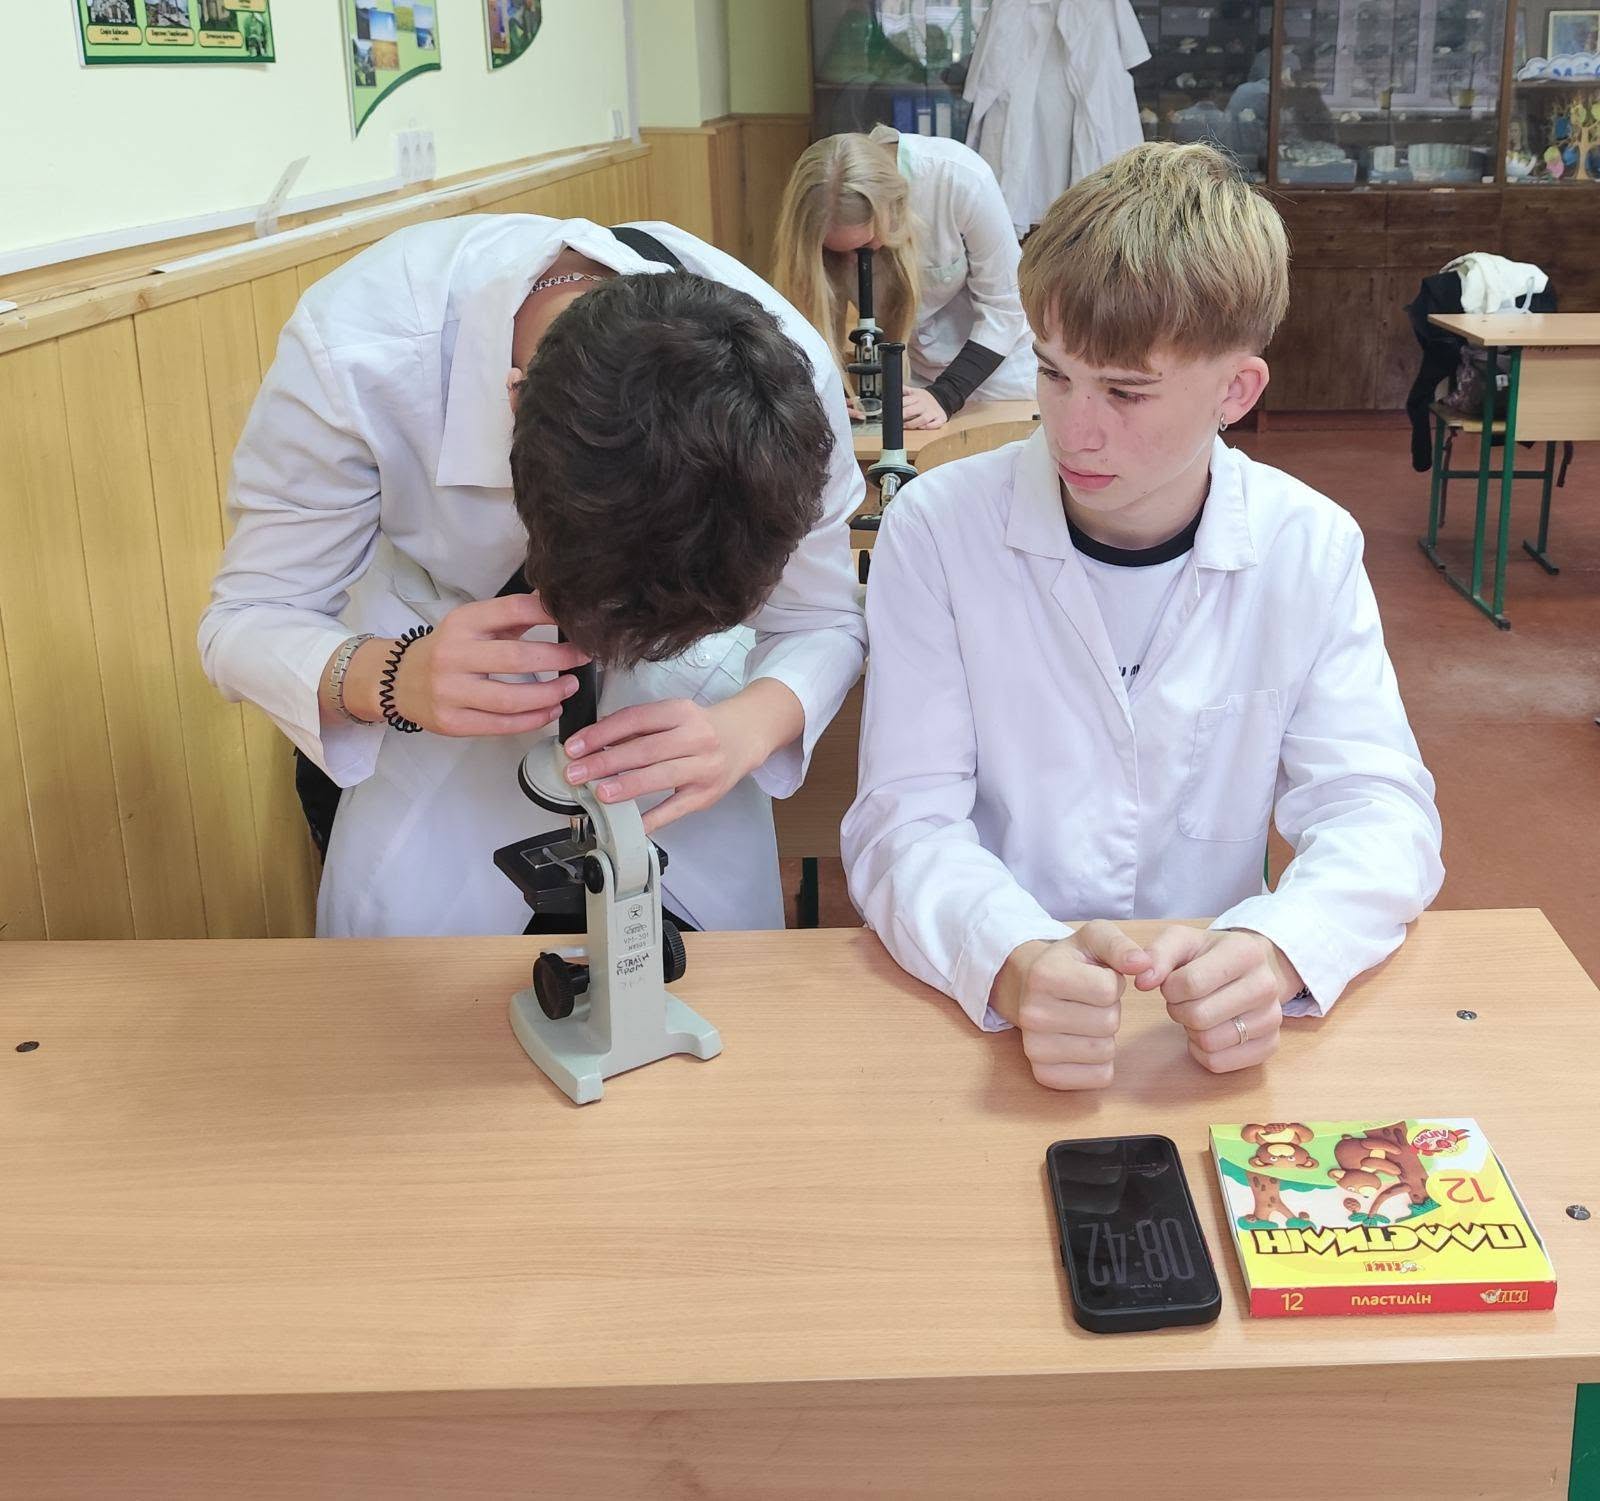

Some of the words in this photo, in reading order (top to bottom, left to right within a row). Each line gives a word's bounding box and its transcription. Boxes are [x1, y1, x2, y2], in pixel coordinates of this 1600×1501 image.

[1439, 1177, 1495, 1204] 12
[1078, 1217, 1196, 1287] 08:42
[1251, 1222, 1527, 1256] ПЛАСТИЛІН
[1281, 1293, 1304, 1312] 12
[1351, 1292, 1432, 1306] пластилін
